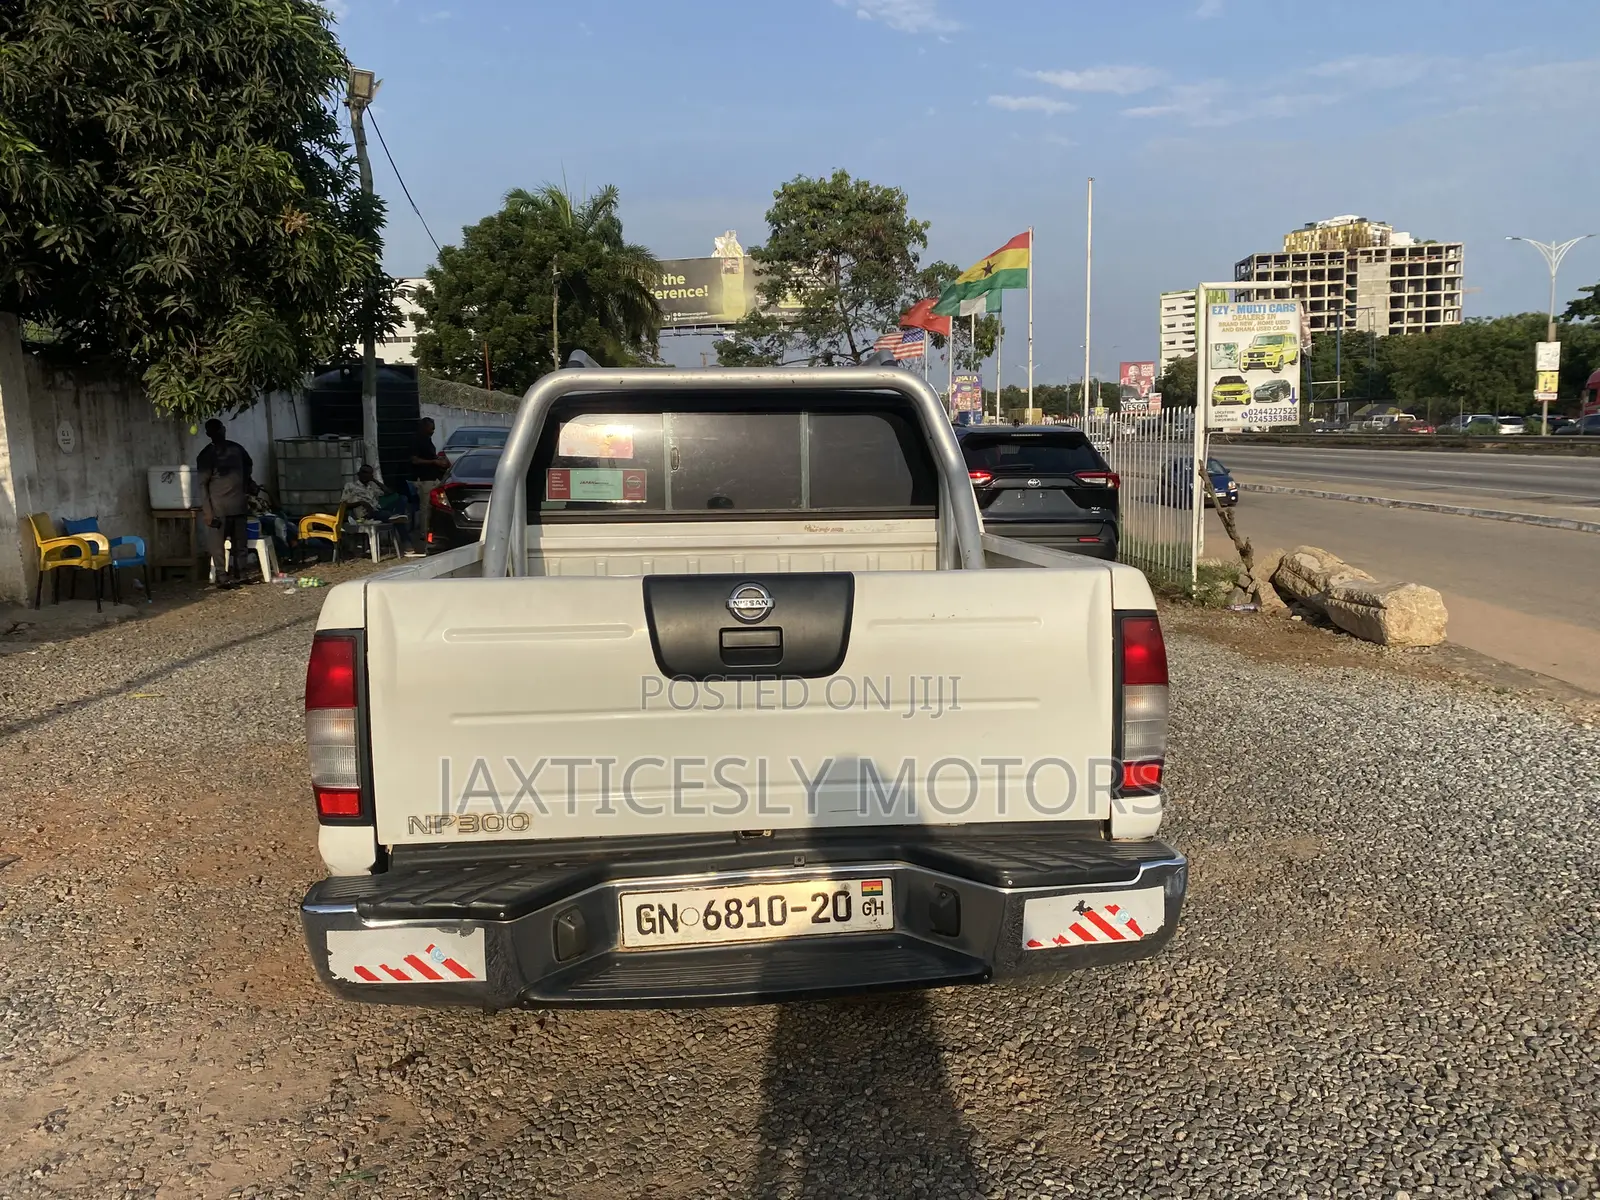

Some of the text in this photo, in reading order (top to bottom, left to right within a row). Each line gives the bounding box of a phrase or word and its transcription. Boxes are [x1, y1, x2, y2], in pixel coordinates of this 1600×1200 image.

[662, 273, 685, 285] the
[1212, 305, 1229, 315] EZY
[1237, 304, 1266, 314] MULTI
[1269, 303, 1296, 313] CARS
[1120, 401, 1147, 411] NESCA
[1248, 407, 1297, 416] 0244227523
[1248, 414, 1297, 423] 0245353863
[732, 599, 769, 607] NISSAN
[408, 812, 530, 835] NP300
[635, 890, 885, 936] GN 6810-20 GH
